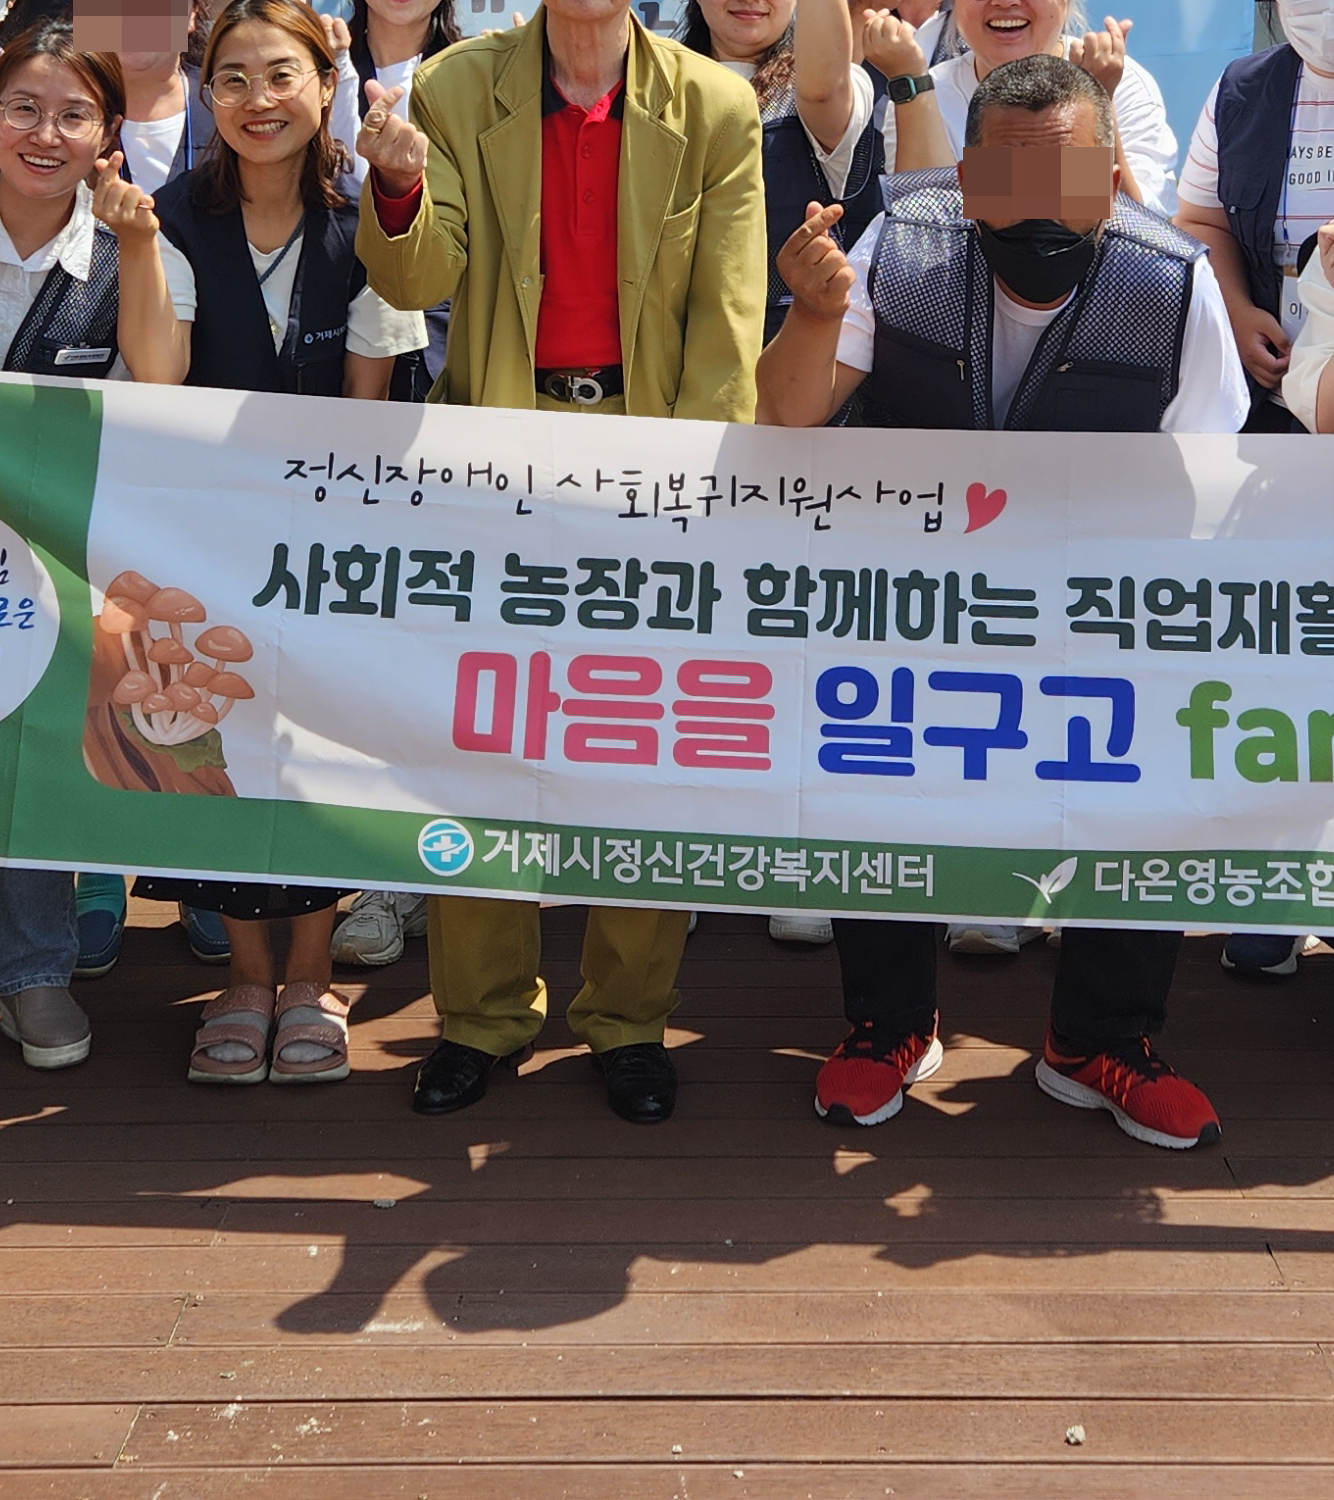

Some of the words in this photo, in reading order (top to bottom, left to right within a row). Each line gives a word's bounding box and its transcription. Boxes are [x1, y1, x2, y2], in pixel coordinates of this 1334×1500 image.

[1289, 171, 1321, 185] GOOD
[1317, 145, 1333, 159] BE
[284, 451, 534, 516] 정신장애인
[556, 469, 946, 534] 사회복귀지원사업
[251, 542, 476, 623] 사회적
[499, 552, 723, 634] 농장과
[743, 562, 1038, 647] 함께하는
[452, 650, 776, 771] 마음을
[814, 665, 1142, 784] 일구고
[481, 827, 936, 898] 거제시정신건강복지센터
